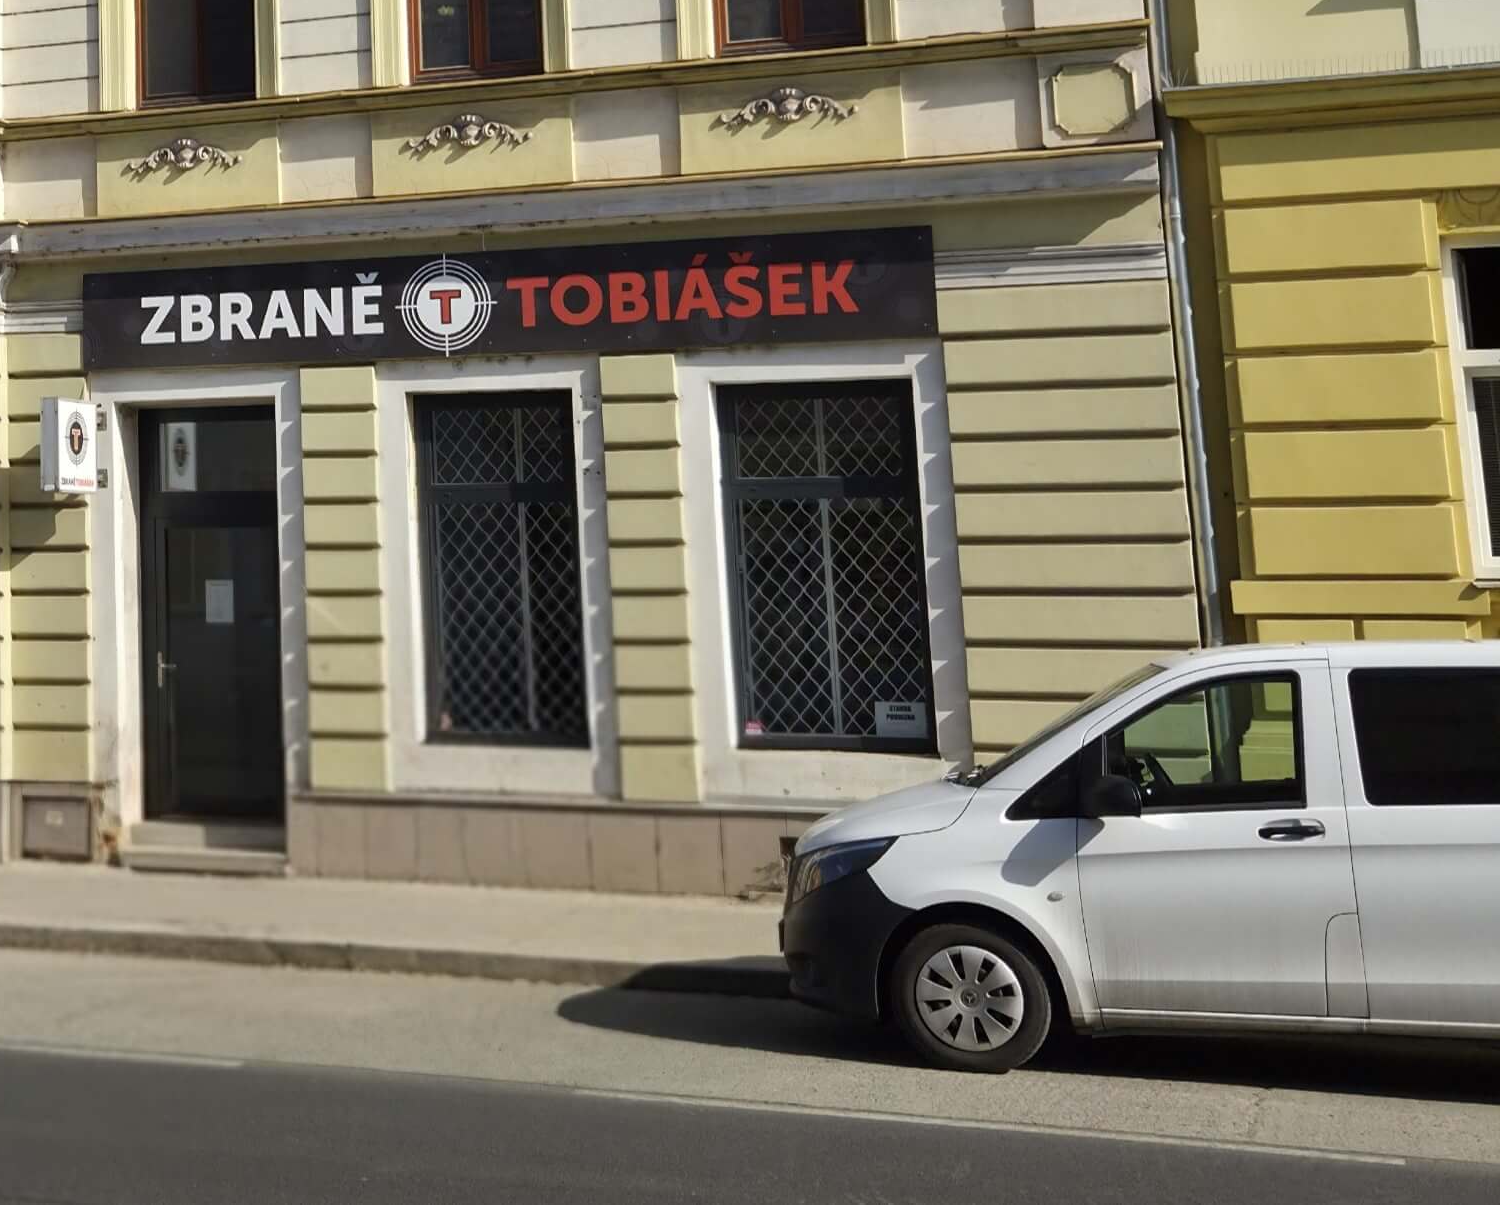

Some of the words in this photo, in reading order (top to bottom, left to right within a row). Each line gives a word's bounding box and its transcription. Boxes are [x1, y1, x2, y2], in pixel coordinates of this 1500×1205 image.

[140, 272, 385, 344] ZBRANĚ
[429, 289, 462, 325] T
[506, 251, 860, 328] TOBIÁŠEK
